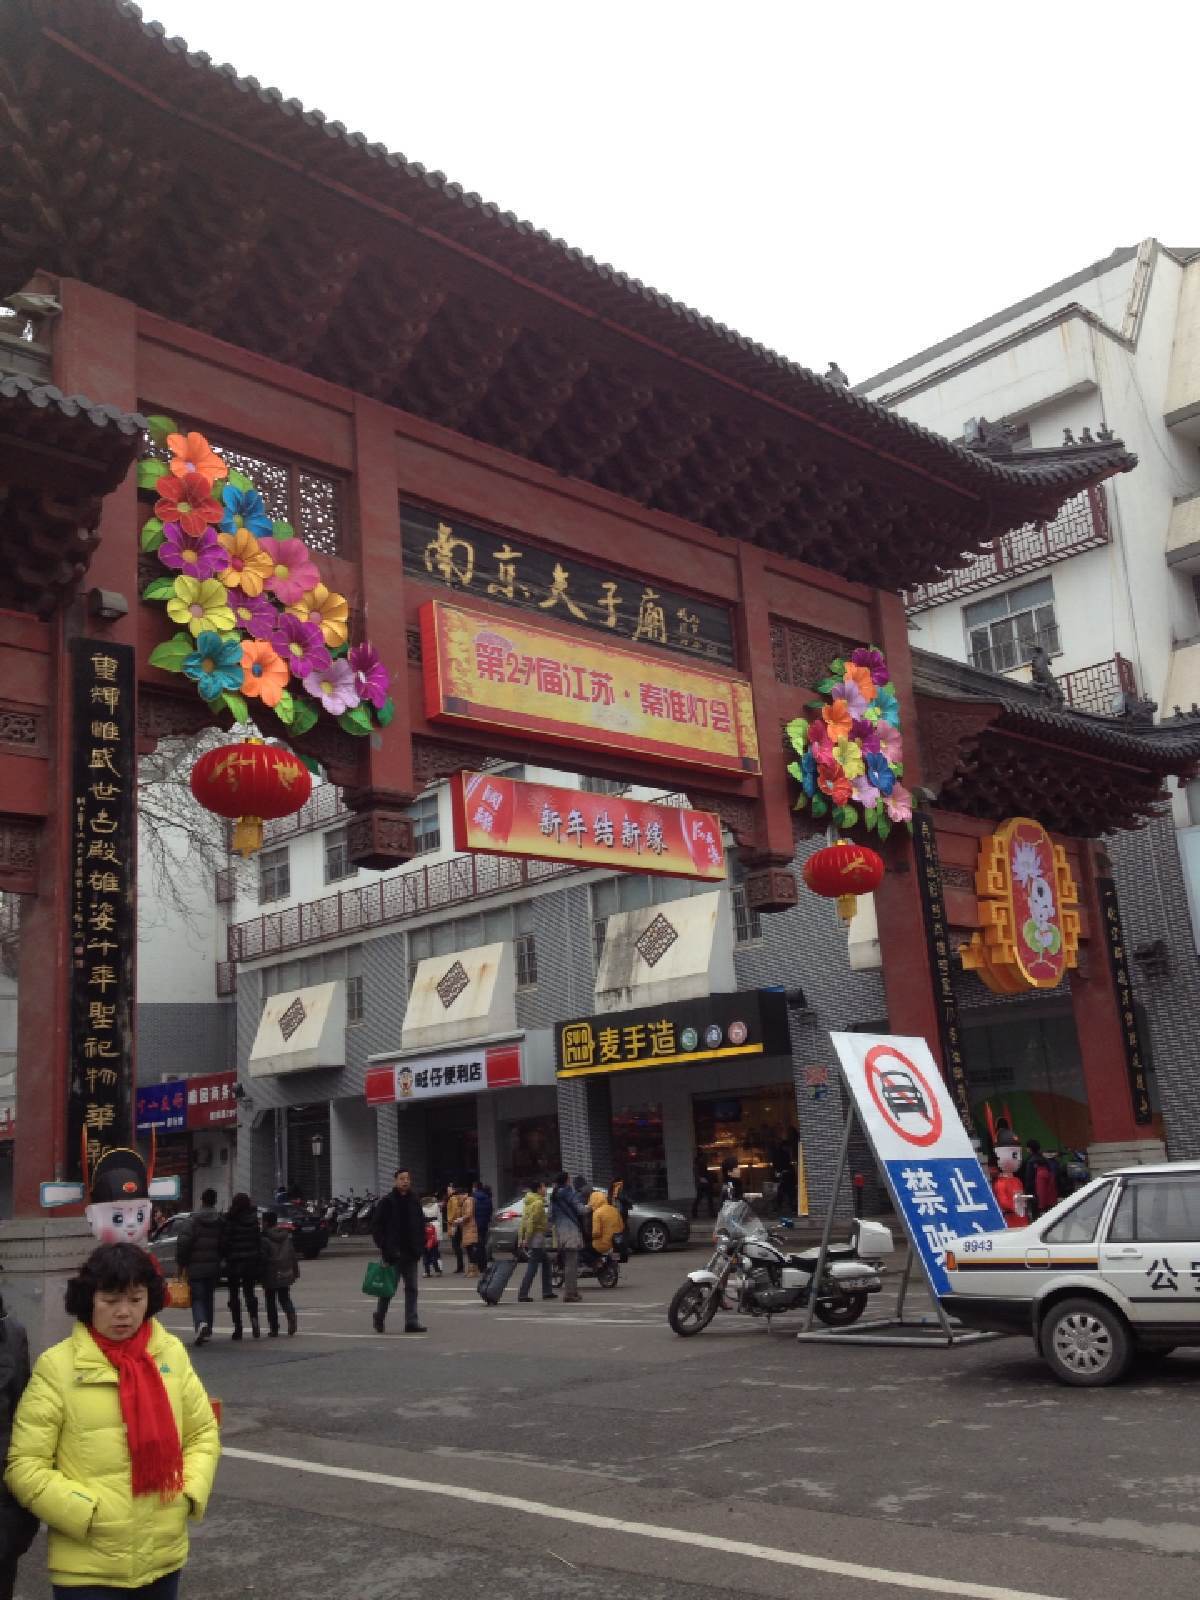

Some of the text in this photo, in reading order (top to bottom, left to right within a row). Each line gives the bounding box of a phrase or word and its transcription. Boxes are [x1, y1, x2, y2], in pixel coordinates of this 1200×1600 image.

[600, 1019, 676, 1063] 麦手造
[902, 1167, 989, 1216] 禁止
[1145, 1257, 1200, 1292] 公
